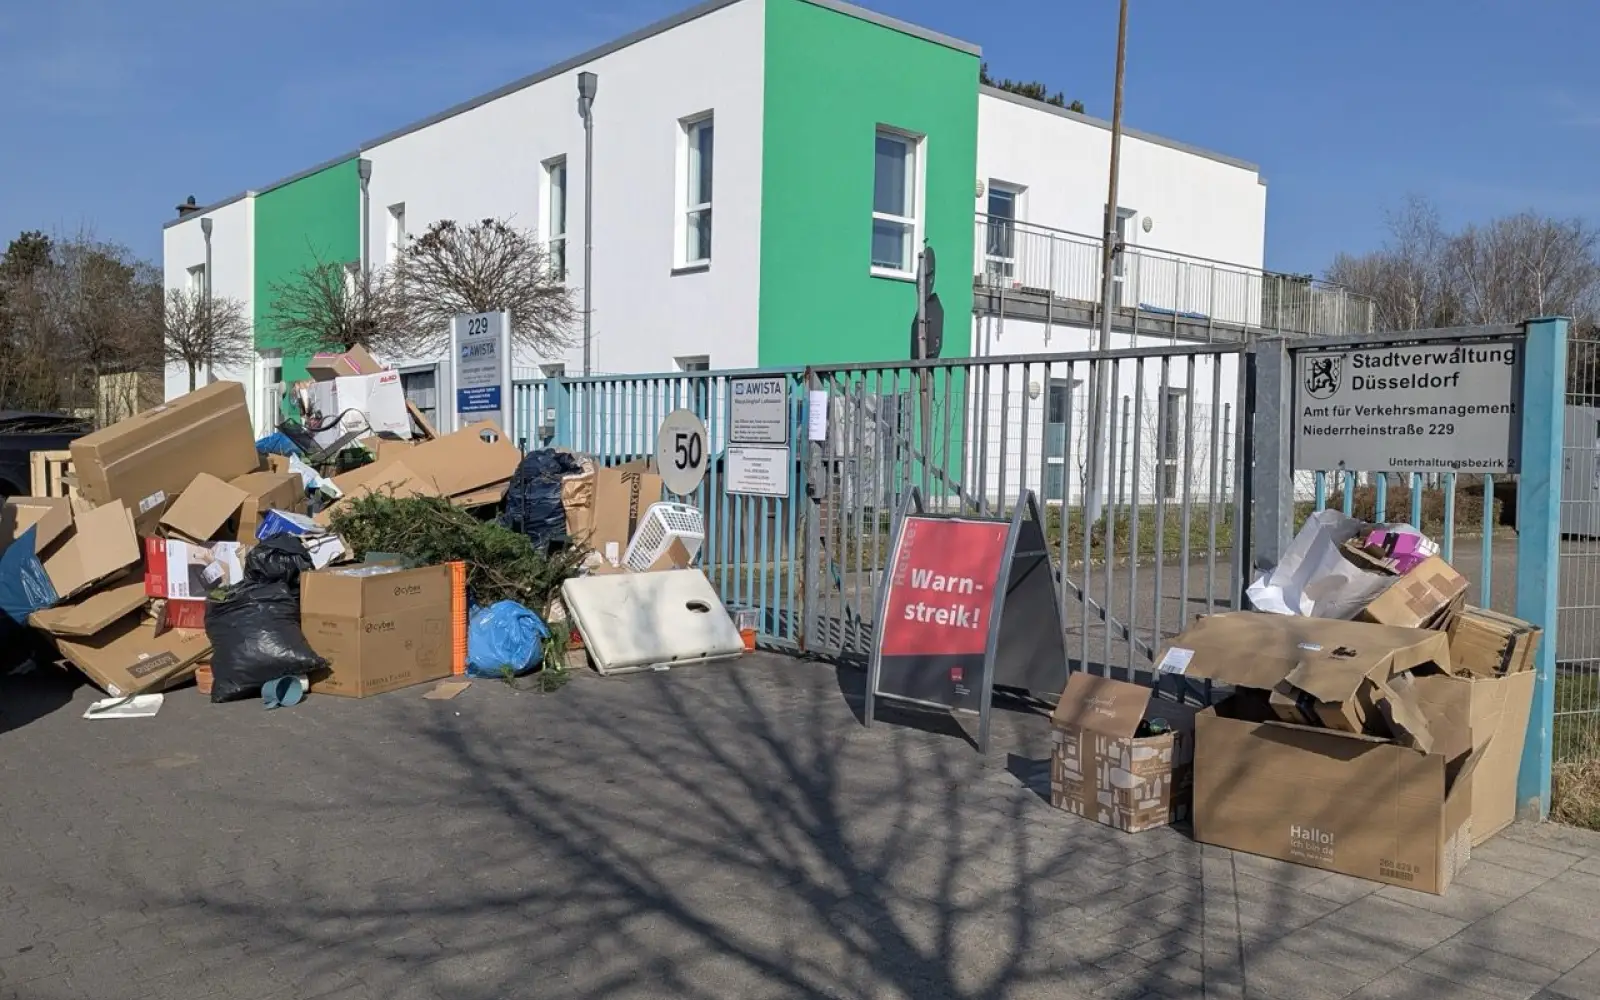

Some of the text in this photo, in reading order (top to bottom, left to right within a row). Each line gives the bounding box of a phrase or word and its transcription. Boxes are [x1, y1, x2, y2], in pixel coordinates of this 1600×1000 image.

[468, 317, 488, 335] 229
[470, 342, 495, 357] AWISTA
[1352, 347, 1516, 369] Stadtverwaltung
[745, 381, 781, 395] AWISTA
[1352, 371, 1460, 390] Düsseldorf
[1303, 401, 1516, 418] Amt für Verkehrsmanagement
[1303, 423, 1455, 436] Niederrheinstraße 229
[675, 432, 702, 470] 50
[1389, 457, 1516, 469] Unterhaltungsbezirk 2
[630, 473, 640, 518] MAXTON
[911, 568, 984, 594] Warn-
[904, 601, 981, 629] streik!
[1290, 824, 1334, 845] Hallo!
[1305, 841, 1320, 852] bin
[1322, 845, 1334, 856] da
